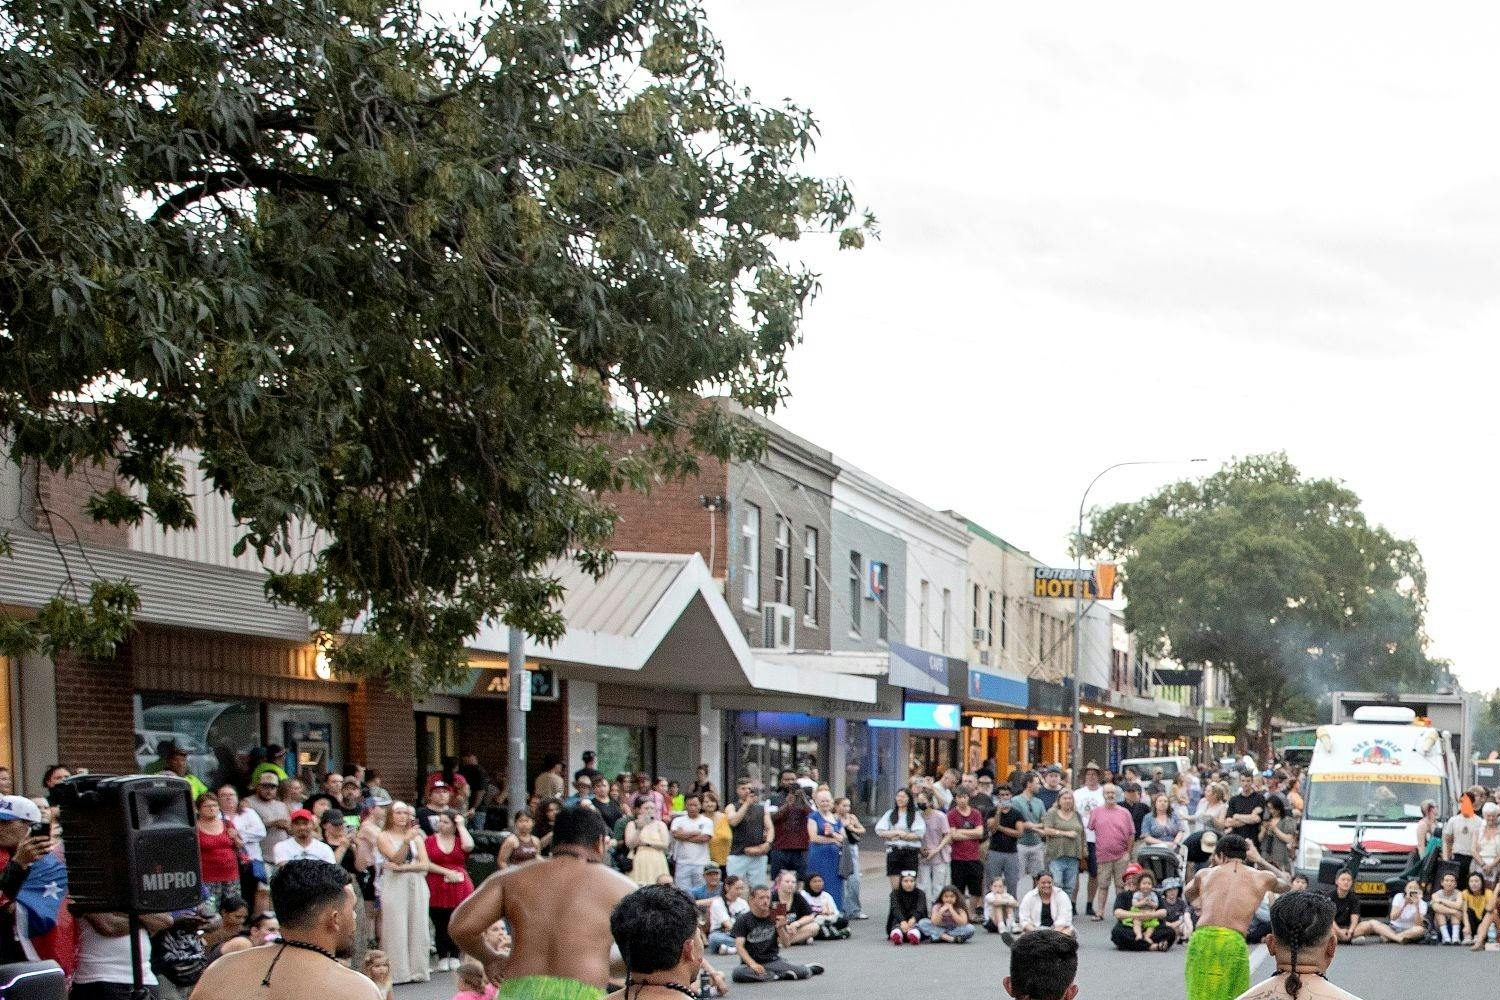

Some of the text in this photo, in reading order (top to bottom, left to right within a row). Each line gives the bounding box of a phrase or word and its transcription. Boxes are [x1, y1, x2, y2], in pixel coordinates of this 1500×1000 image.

[1036, 578, 1092, 599] HOTEL
[1376, 774, 1432, 783] Children
[143, 871, 197, 891] MIPRO
